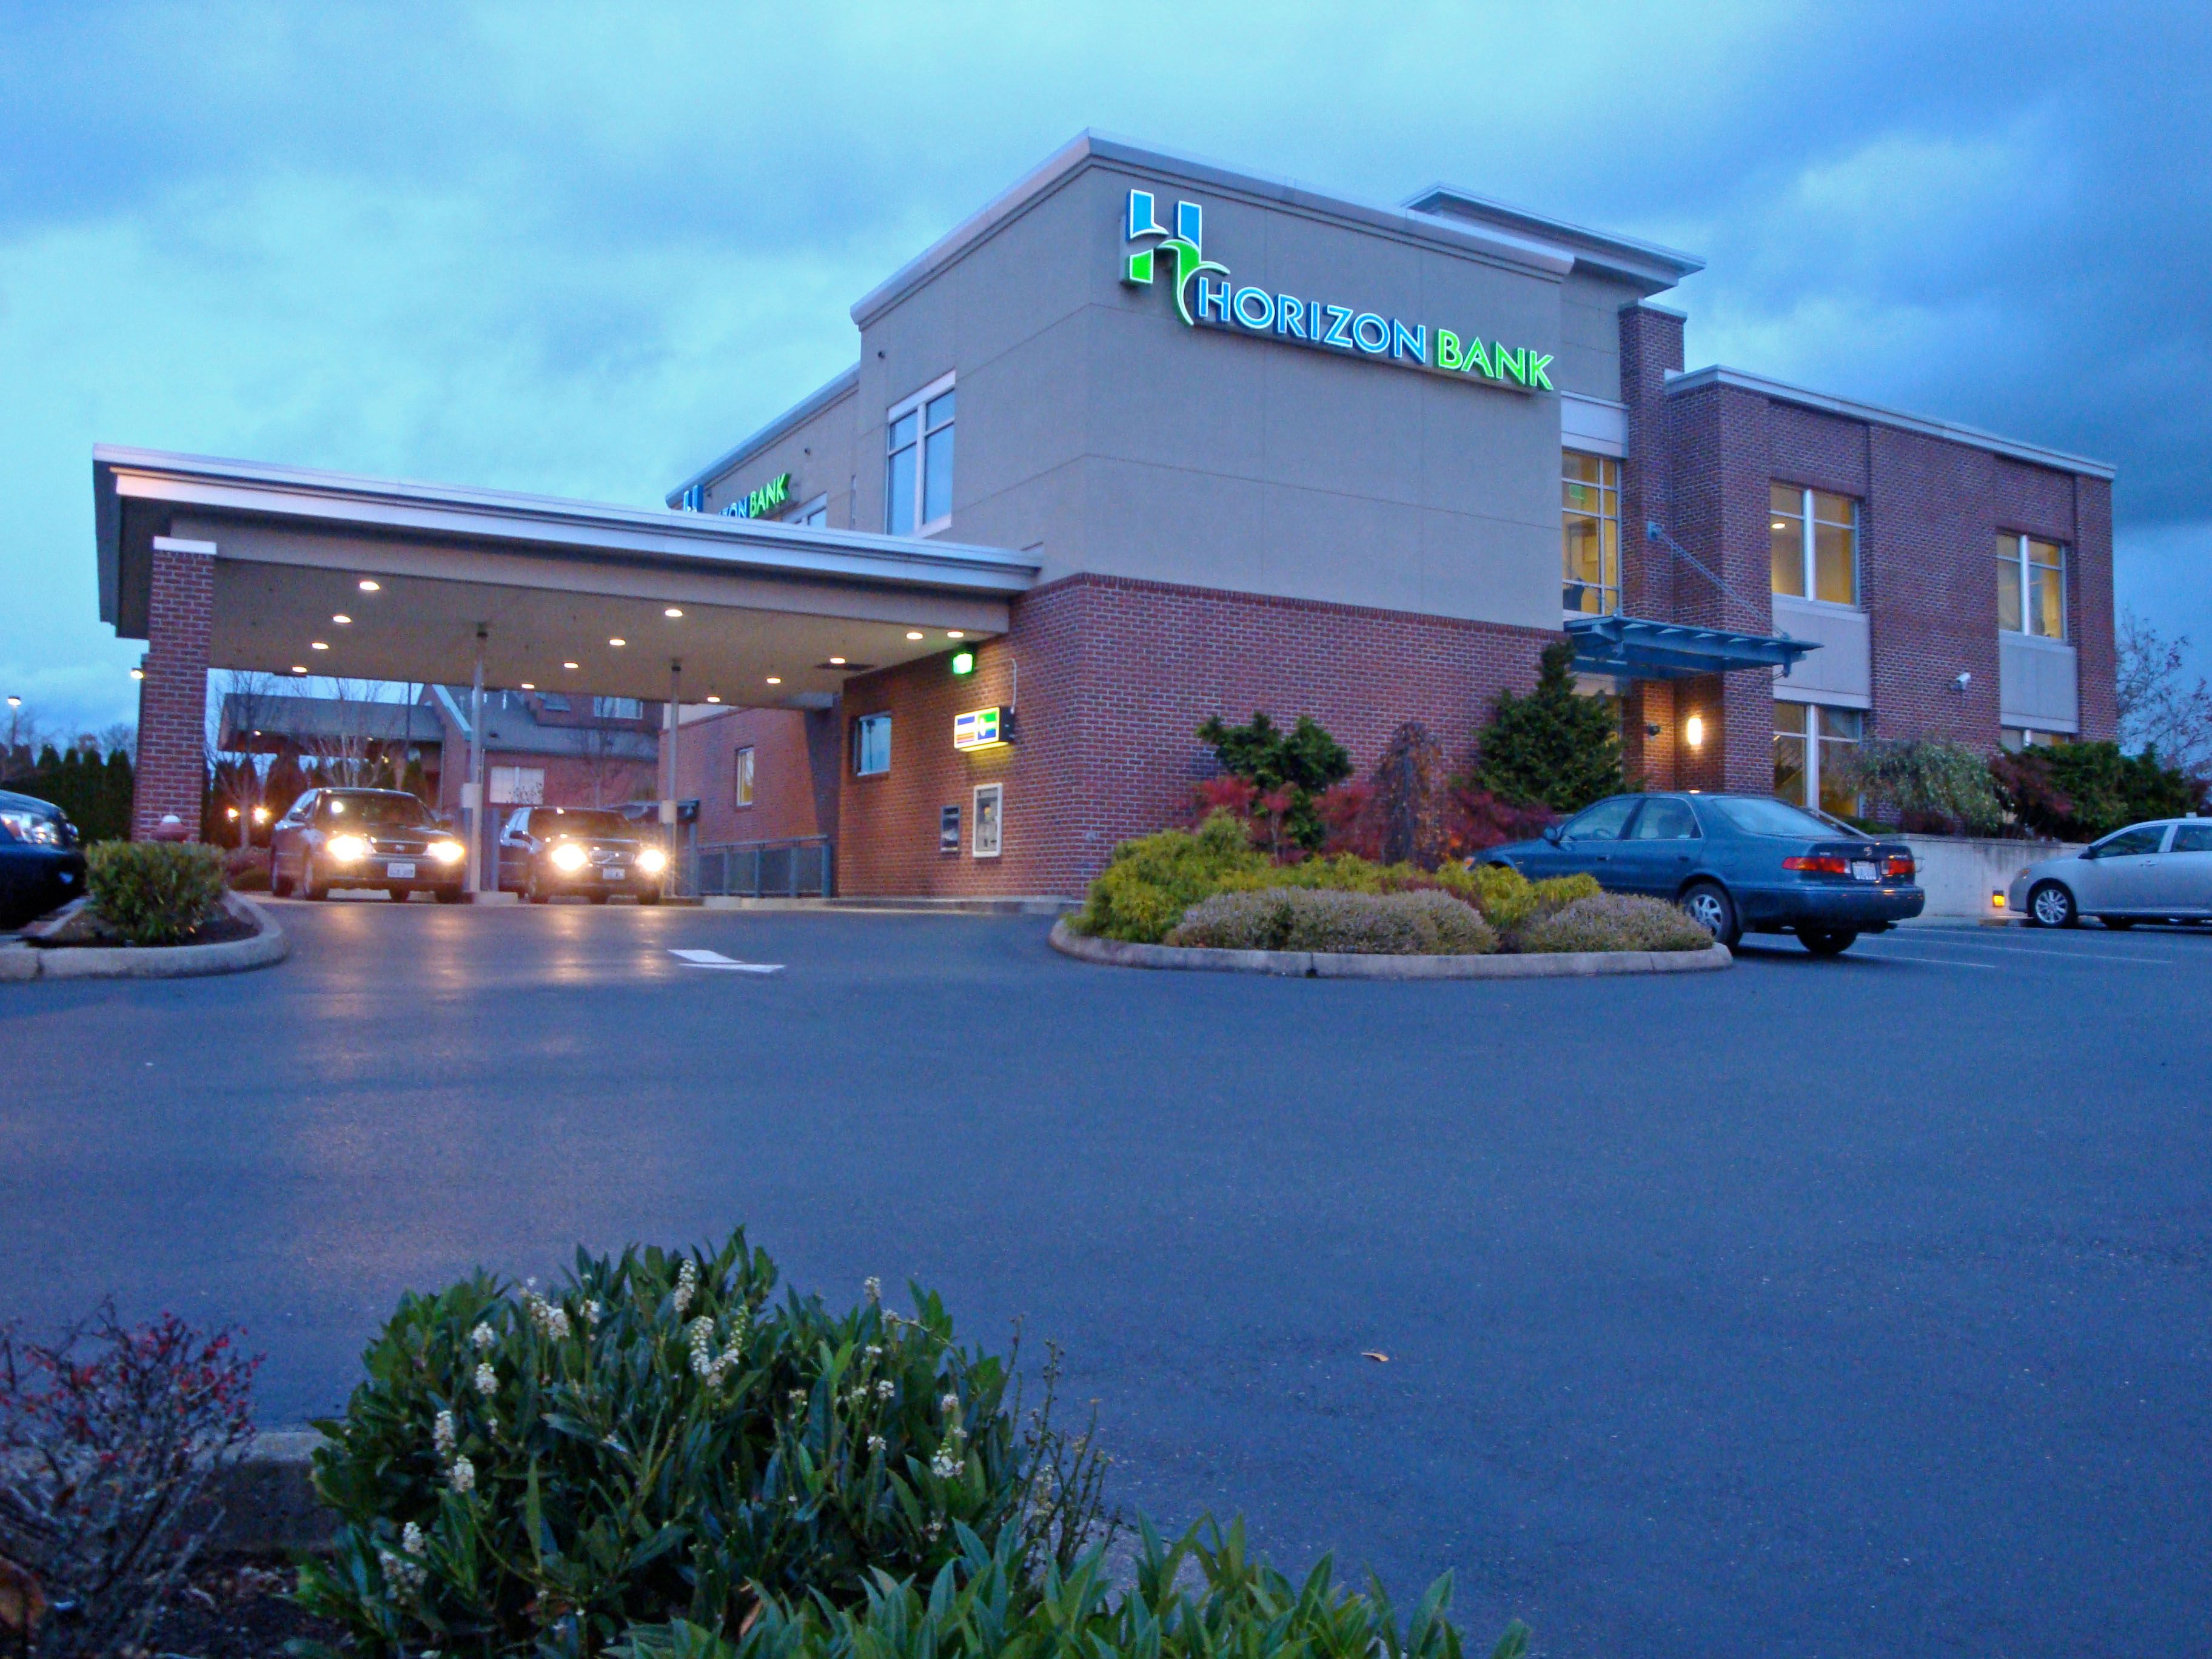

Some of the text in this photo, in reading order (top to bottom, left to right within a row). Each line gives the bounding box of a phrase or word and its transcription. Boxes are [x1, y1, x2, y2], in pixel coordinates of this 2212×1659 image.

[1196, 276, 1555, 390] HORIZON BANK
[749, 472, 788, 518] BANK
